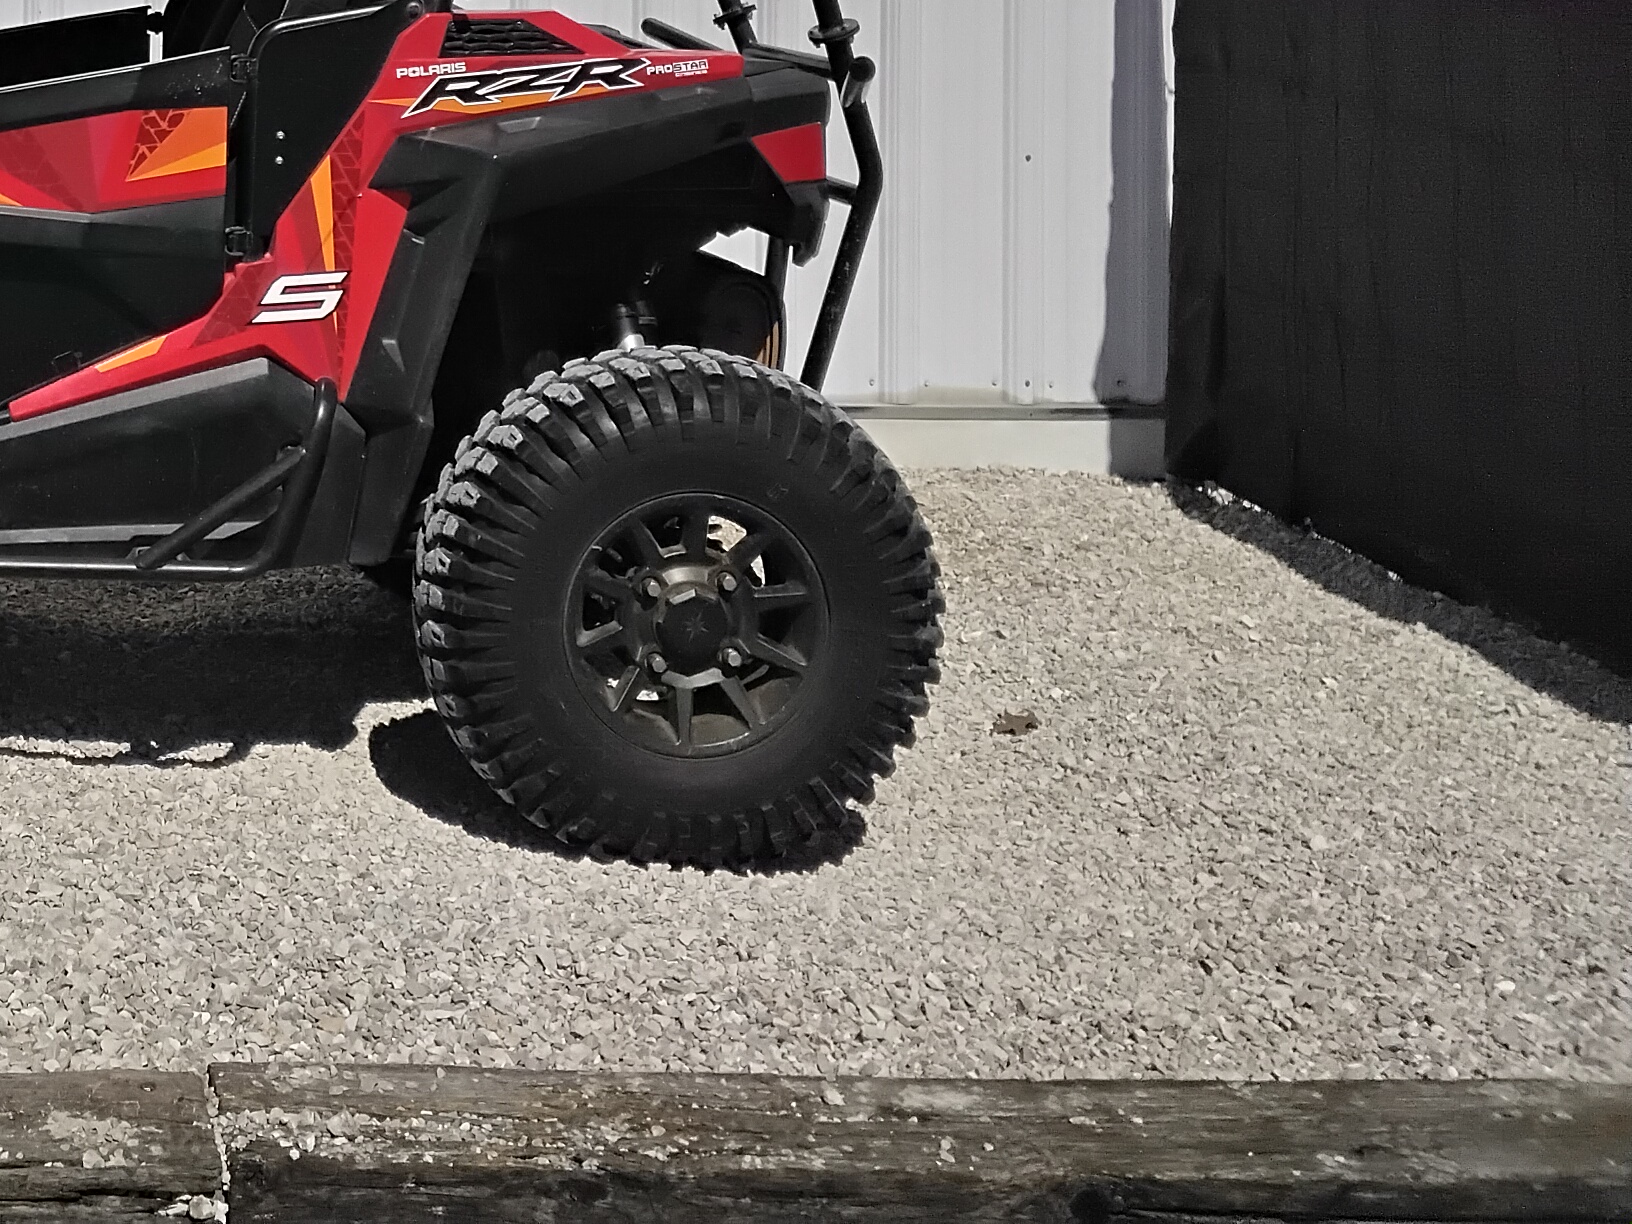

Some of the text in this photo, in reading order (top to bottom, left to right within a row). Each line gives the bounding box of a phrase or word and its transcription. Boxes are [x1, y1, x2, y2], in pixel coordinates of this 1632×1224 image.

[395, 62, 467, 79] POLARIS
[645, 59, 709, 76] PROSTAR
[401, 57, 652, 119] RZR
[249, 271, 349, 325] S
